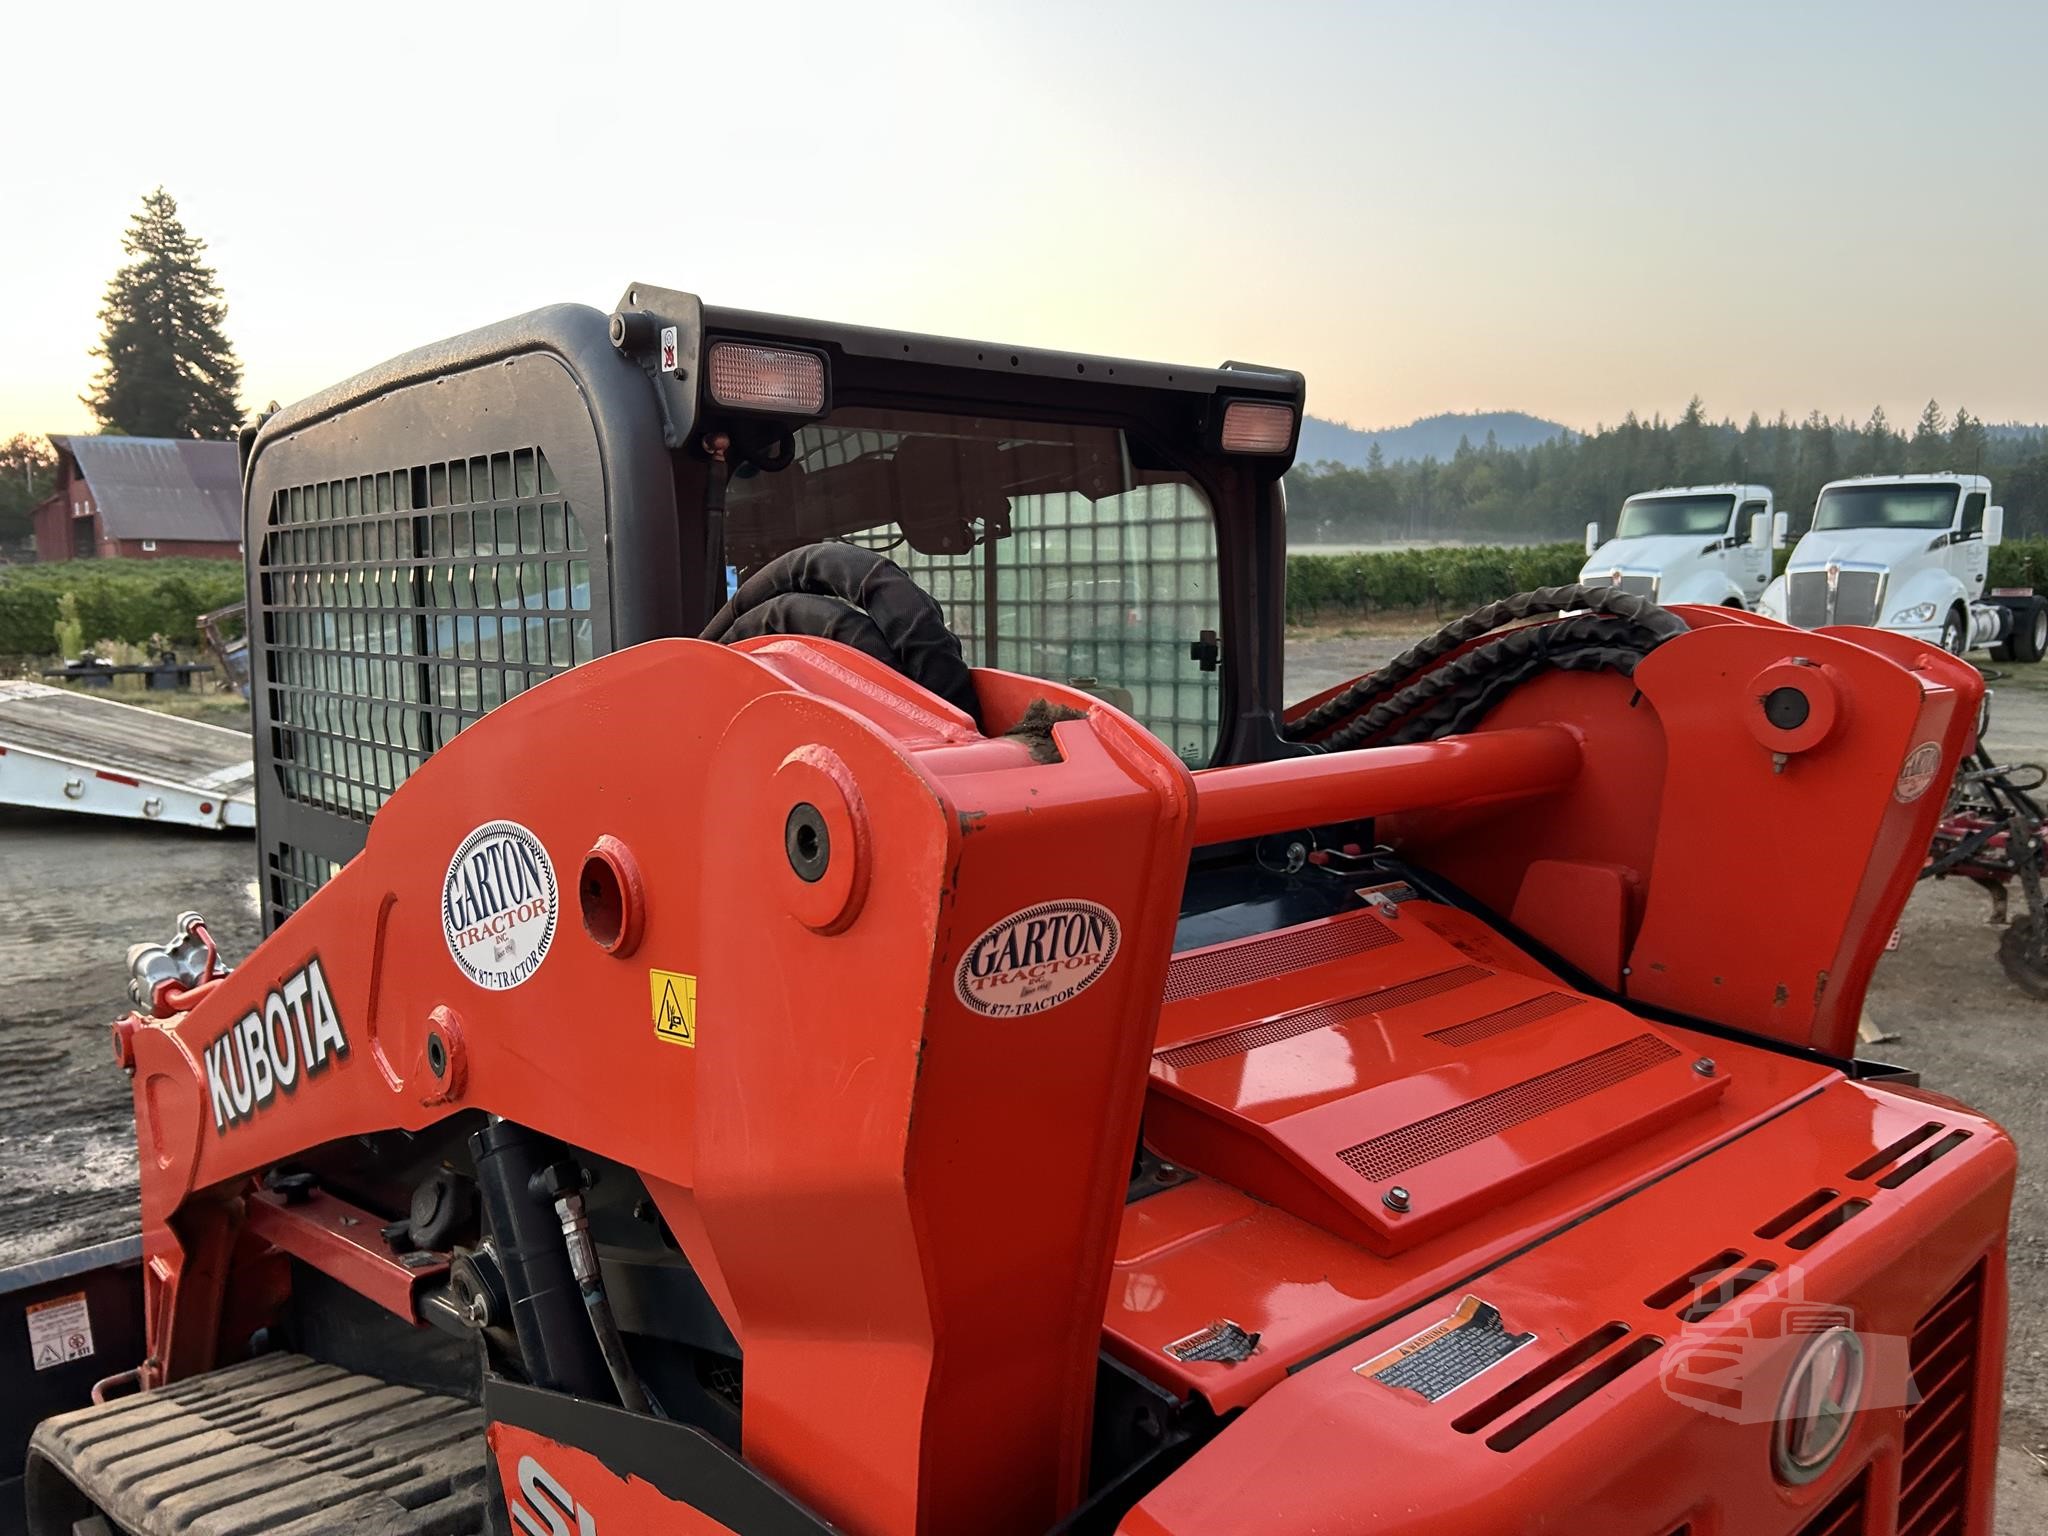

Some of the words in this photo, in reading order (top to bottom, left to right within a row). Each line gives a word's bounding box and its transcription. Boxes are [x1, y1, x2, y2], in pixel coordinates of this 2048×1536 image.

[446, 839, 543, 932] GARTON
[455, 897, 549, 949] TRACTOR
[970, 913, 1106, 978] GARTON
[971, 952, 1101, 991] TRACTOR
[203, 957, 347, 1132] KUBOTA
[1409, 1326, 1450, 1351] WARNING
